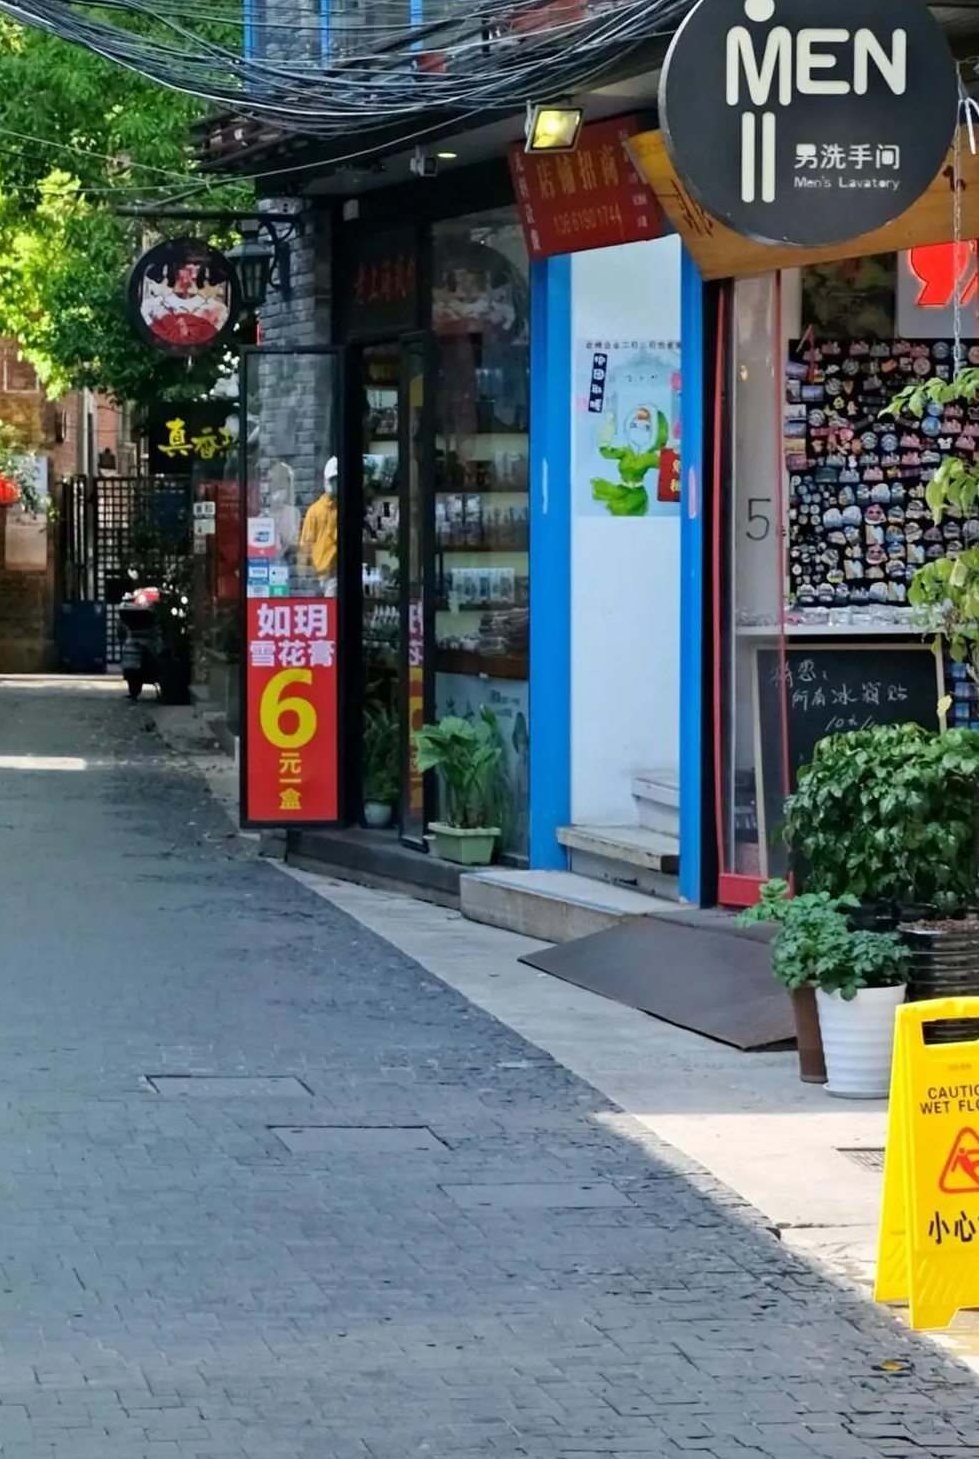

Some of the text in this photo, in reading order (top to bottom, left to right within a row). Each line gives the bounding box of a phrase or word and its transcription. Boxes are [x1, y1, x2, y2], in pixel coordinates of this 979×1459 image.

[726, 25, 907, 106] MEN
[794, 143, 901, 170] 男洗手间
[793, 174, 901, 191] Men's Lavatory
[744, 497, 772, 541] 5
[256, 602, 329, 639] 如玥
[249, 639, 335, 668] 雪花膏
[259, 667, 318, 749] 6
[278, 751, 303, 811] 元一盒
[919, 1100, 951, 1115] WET
[927, 1084, 979, 1100] CAUTIO
[928, 1210, 979, 1245] 小心
